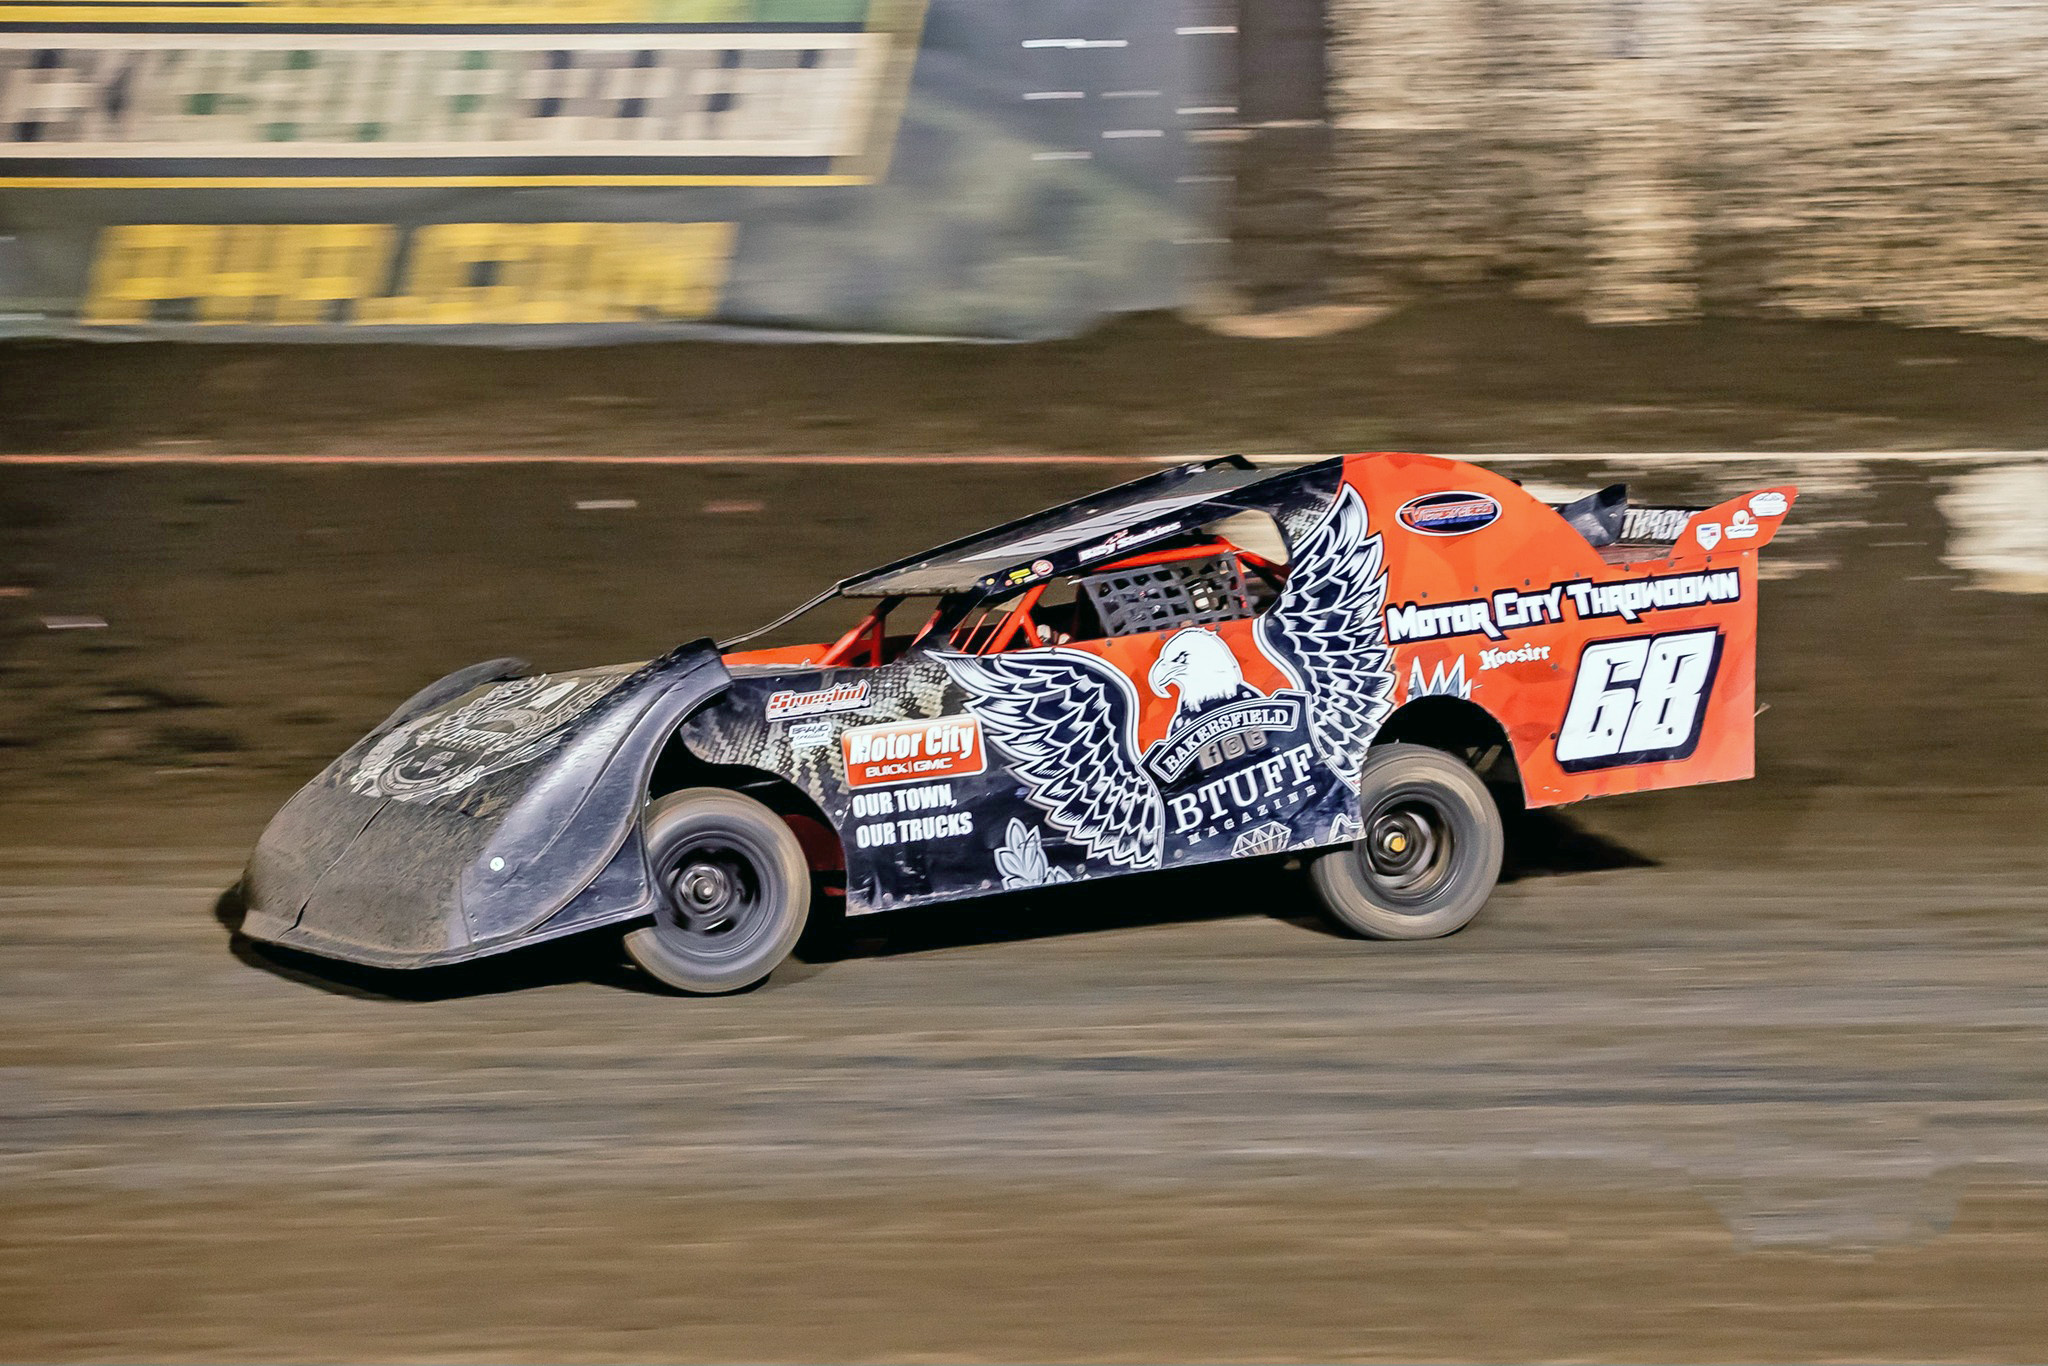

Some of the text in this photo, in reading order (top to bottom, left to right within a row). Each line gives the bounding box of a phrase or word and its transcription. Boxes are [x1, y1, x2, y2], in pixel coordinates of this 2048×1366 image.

[1555, 630, 1718, 763] 68
[849, 724, 975, 765] Motor City
[1162, 708, 1289, 774] BAKERSFIELD
[865, 757, 954, 778] BUICK GMC
[1166, 742, 1314, 835] BTUFF
[852, 783, 958, 819] OUR TOWN,
[1186, 783, 1317, 846] MAGAZINE
[856, 811, 974, 849] OUR TRUCKS
